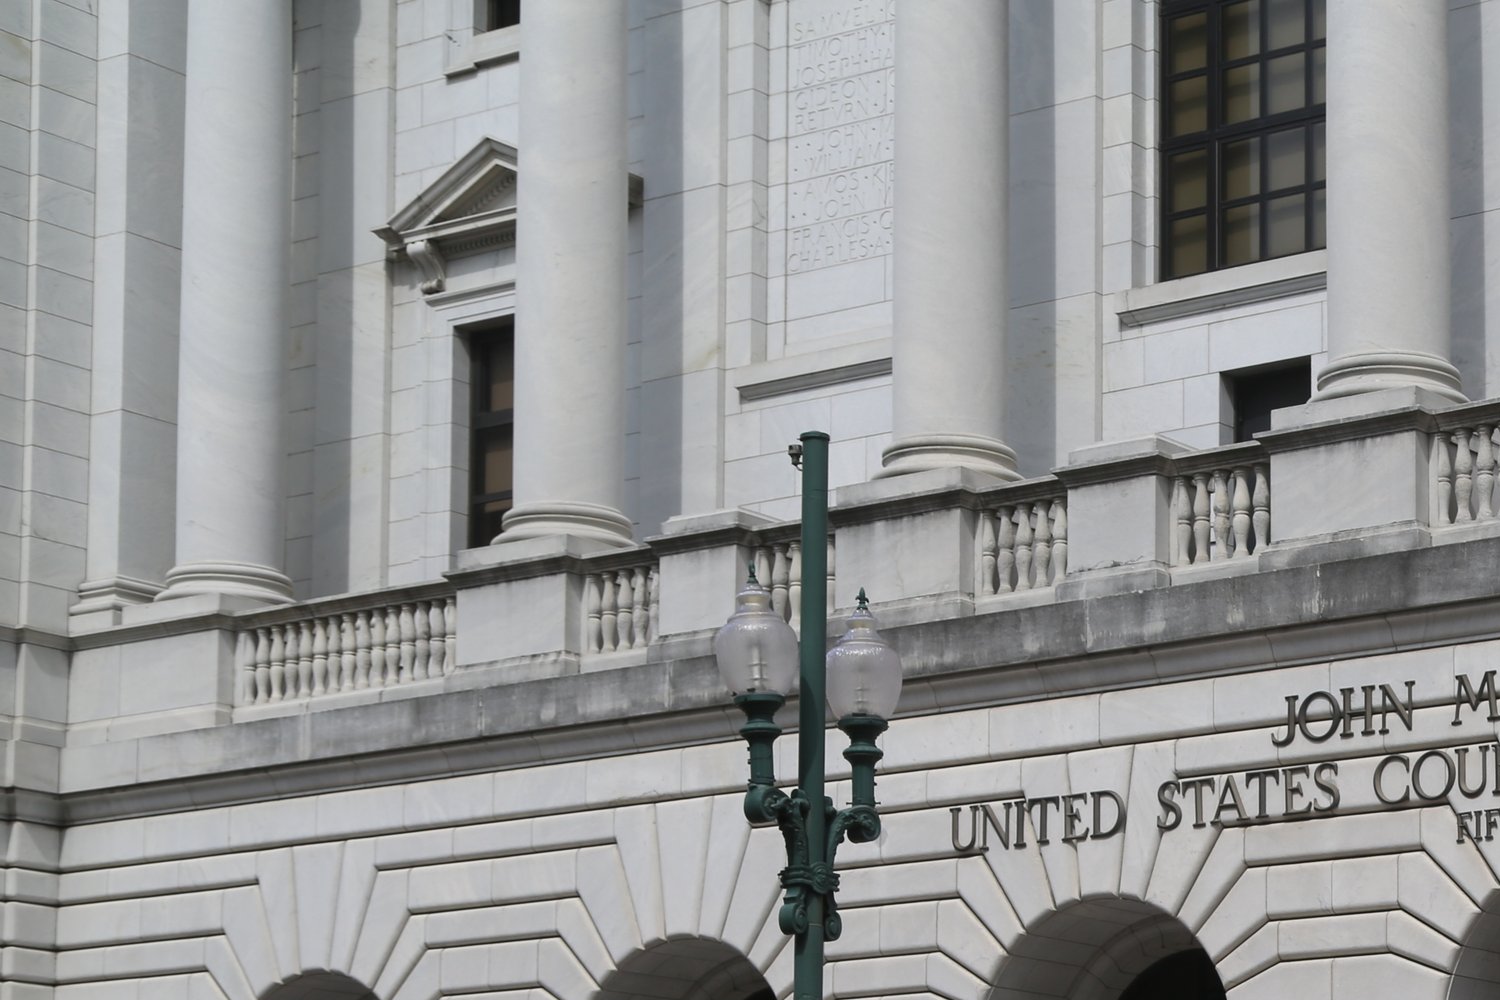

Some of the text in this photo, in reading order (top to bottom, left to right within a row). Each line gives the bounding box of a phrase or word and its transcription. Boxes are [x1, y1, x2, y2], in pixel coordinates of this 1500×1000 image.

[794, 75, 870, 112] GIDEON
[1270, 679, 1417, 748] JOHN
[949, 790, 1127, 853] UNITED
[1156, 761, 1340, 832] STATES
